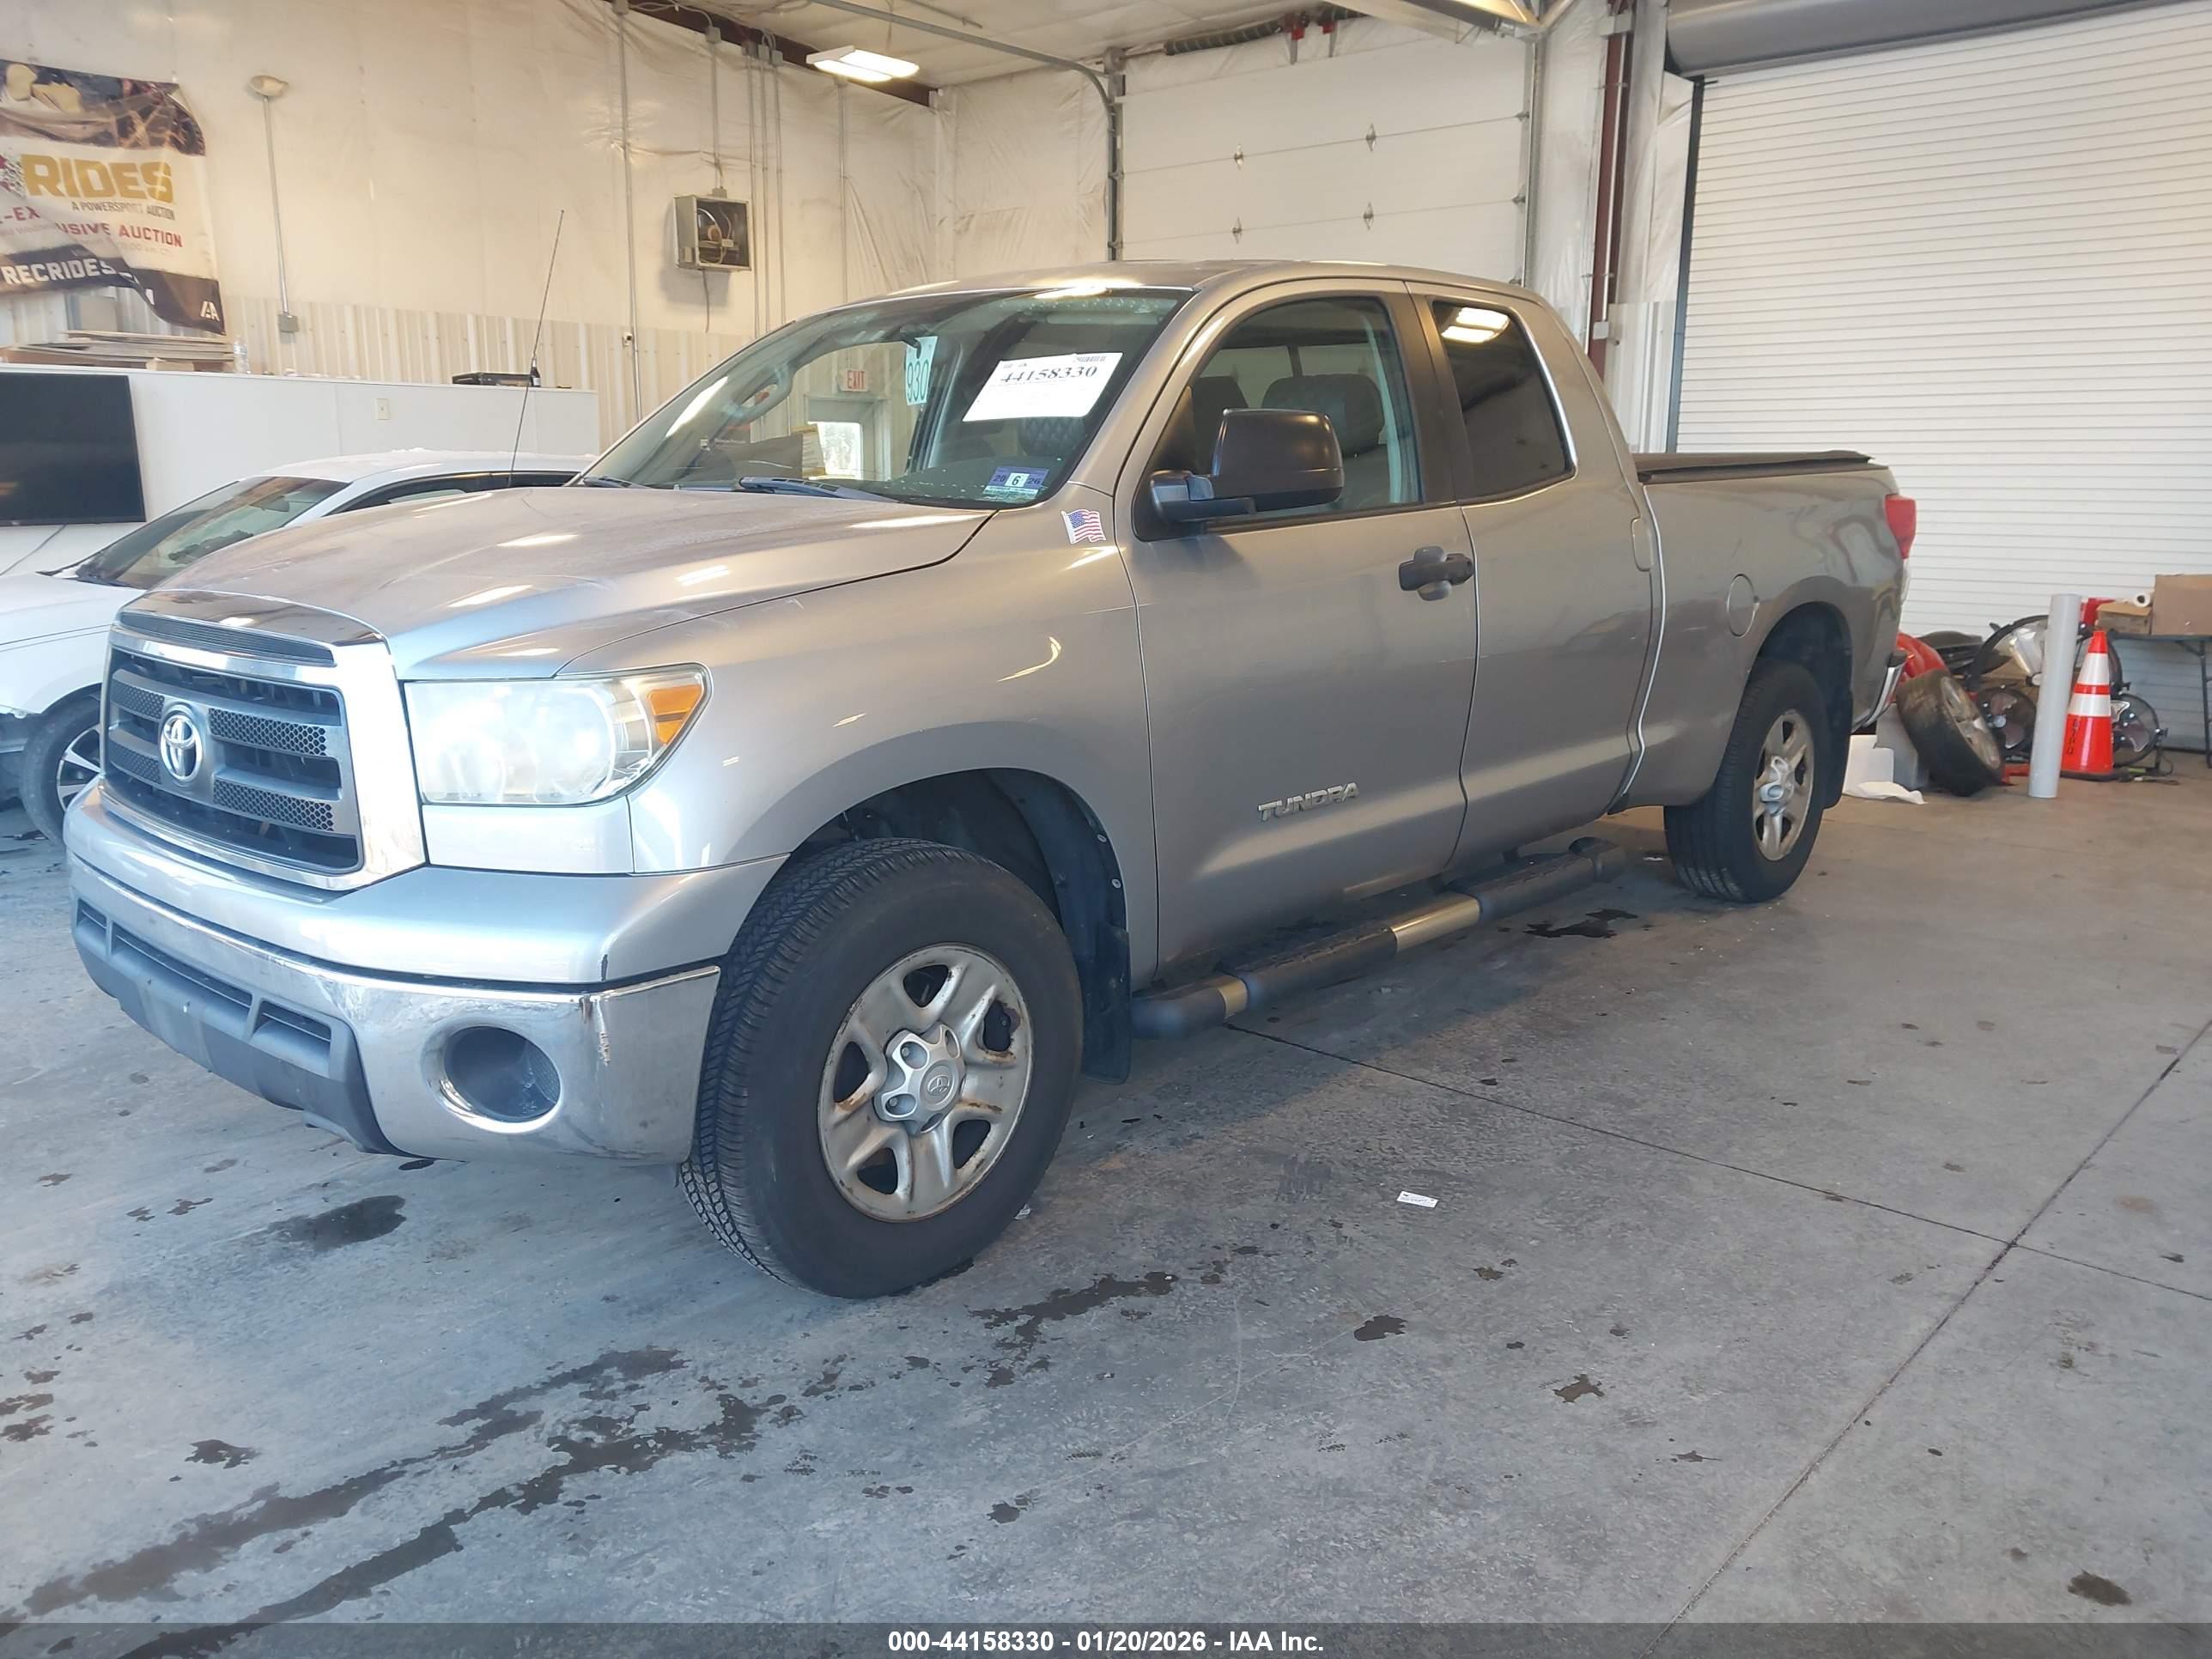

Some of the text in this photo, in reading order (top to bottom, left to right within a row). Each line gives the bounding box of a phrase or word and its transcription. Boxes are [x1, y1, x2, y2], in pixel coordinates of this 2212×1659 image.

[20, 154, 174, 204] RIDES
[118, 224, 183, 247] AUCTION
[846, 369, 866, 390] EXIT
[907, 359, 929, 403] 930
[1000, 366, 1098, 383] 44158330
[1011, 475, 1022, 486] 6
[1257, 781, 1359, 822] TUNDRA
